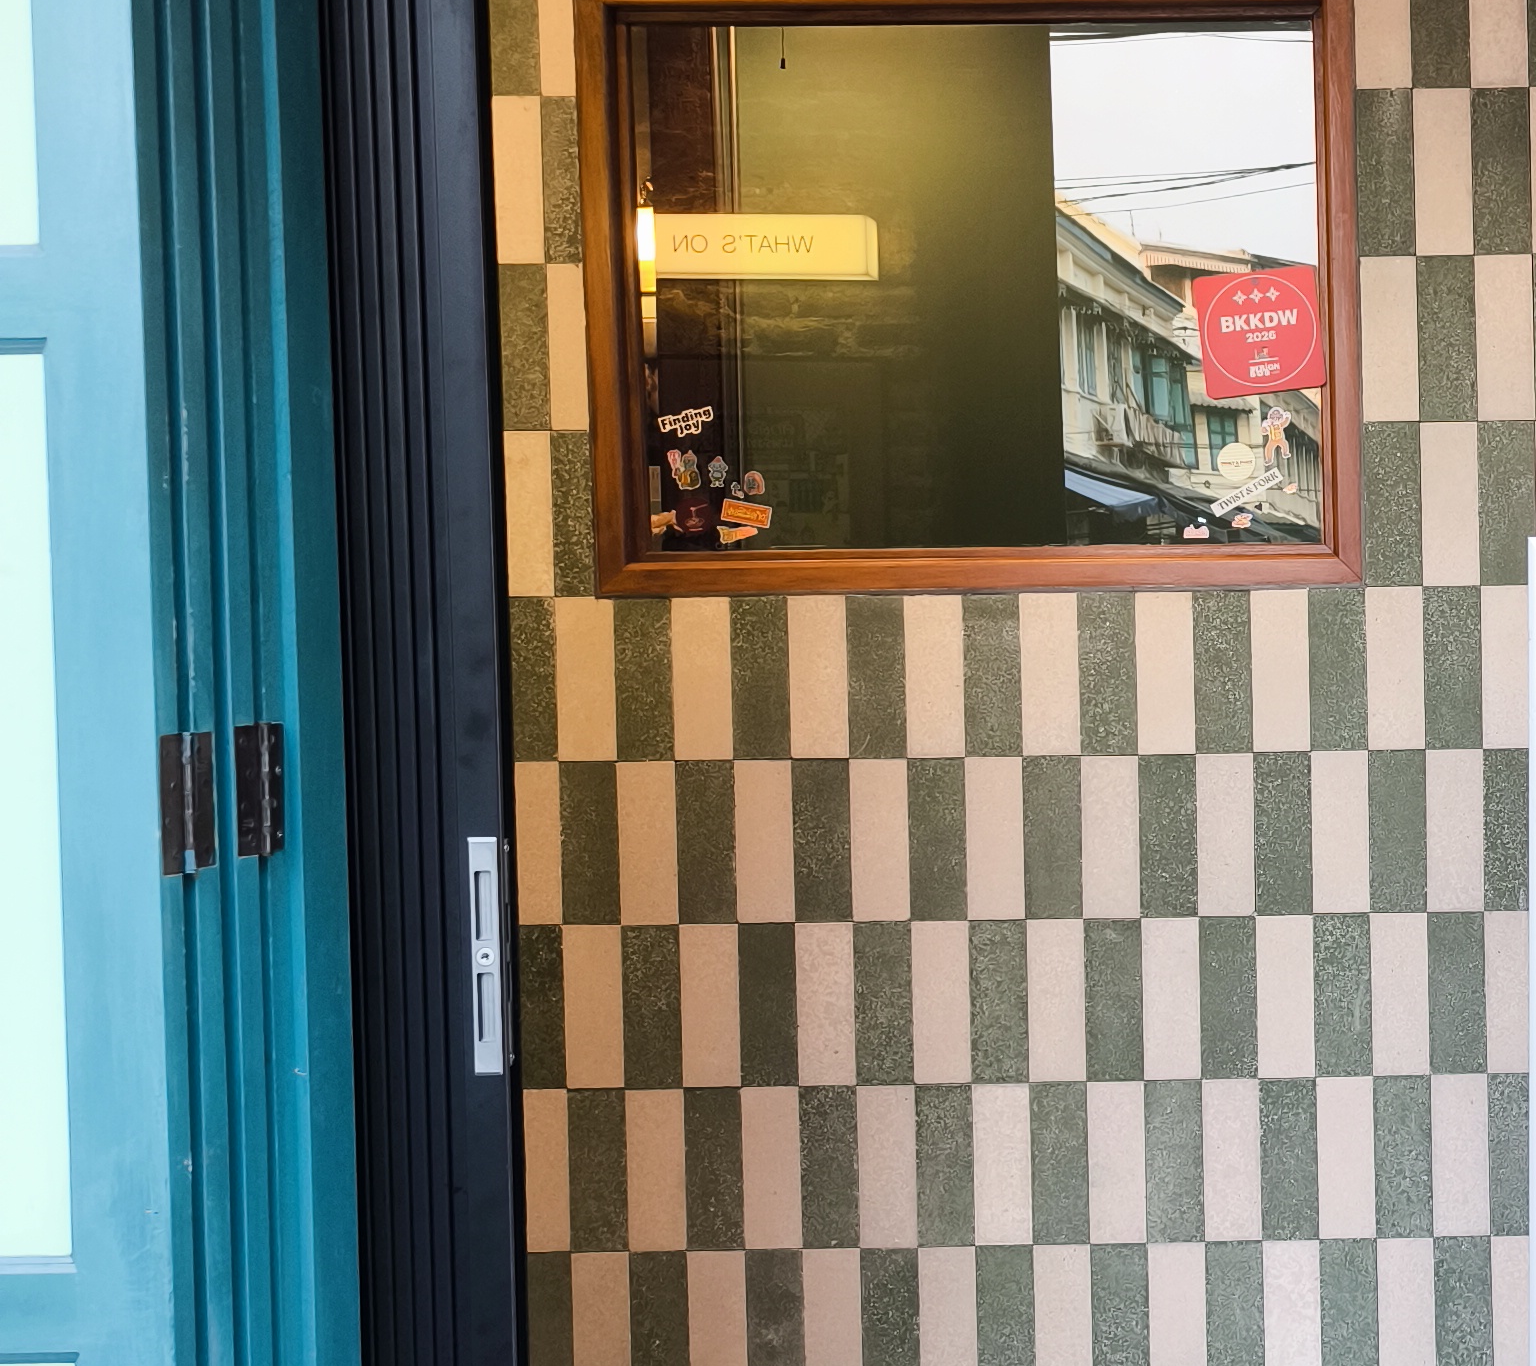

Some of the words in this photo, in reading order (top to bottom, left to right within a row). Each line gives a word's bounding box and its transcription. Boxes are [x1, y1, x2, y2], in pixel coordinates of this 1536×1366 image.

[1220, 309, 1298, 333] BKKDW
[660, 408, 712, 431] Finding
[1217, 490, 1245, 510] TWIST
[1245, 486, 1254, 495] &
[1252, 471, 1279, 491] FORK
